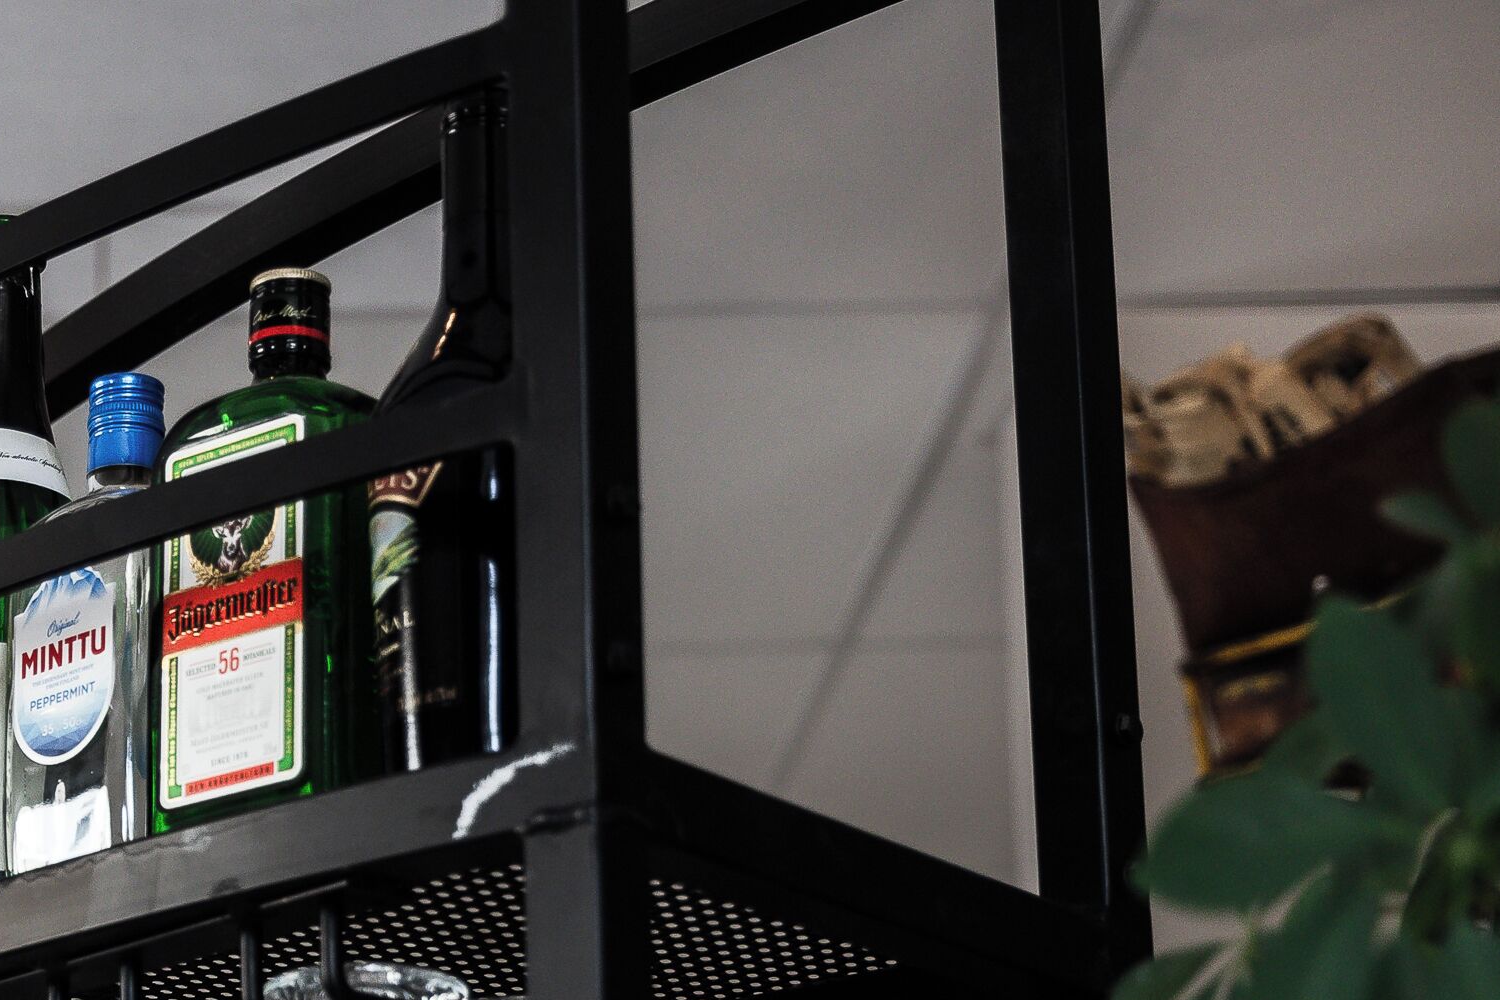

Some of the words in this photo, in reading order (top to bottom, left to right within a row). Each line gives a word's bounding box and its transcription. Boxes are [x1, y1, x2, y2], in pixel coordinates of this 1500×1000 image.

[21, 625, 107, 680] MINTTU
[218, 647, 240, 675] 56
[30, 682, 96, 711] PEPPERMINT
